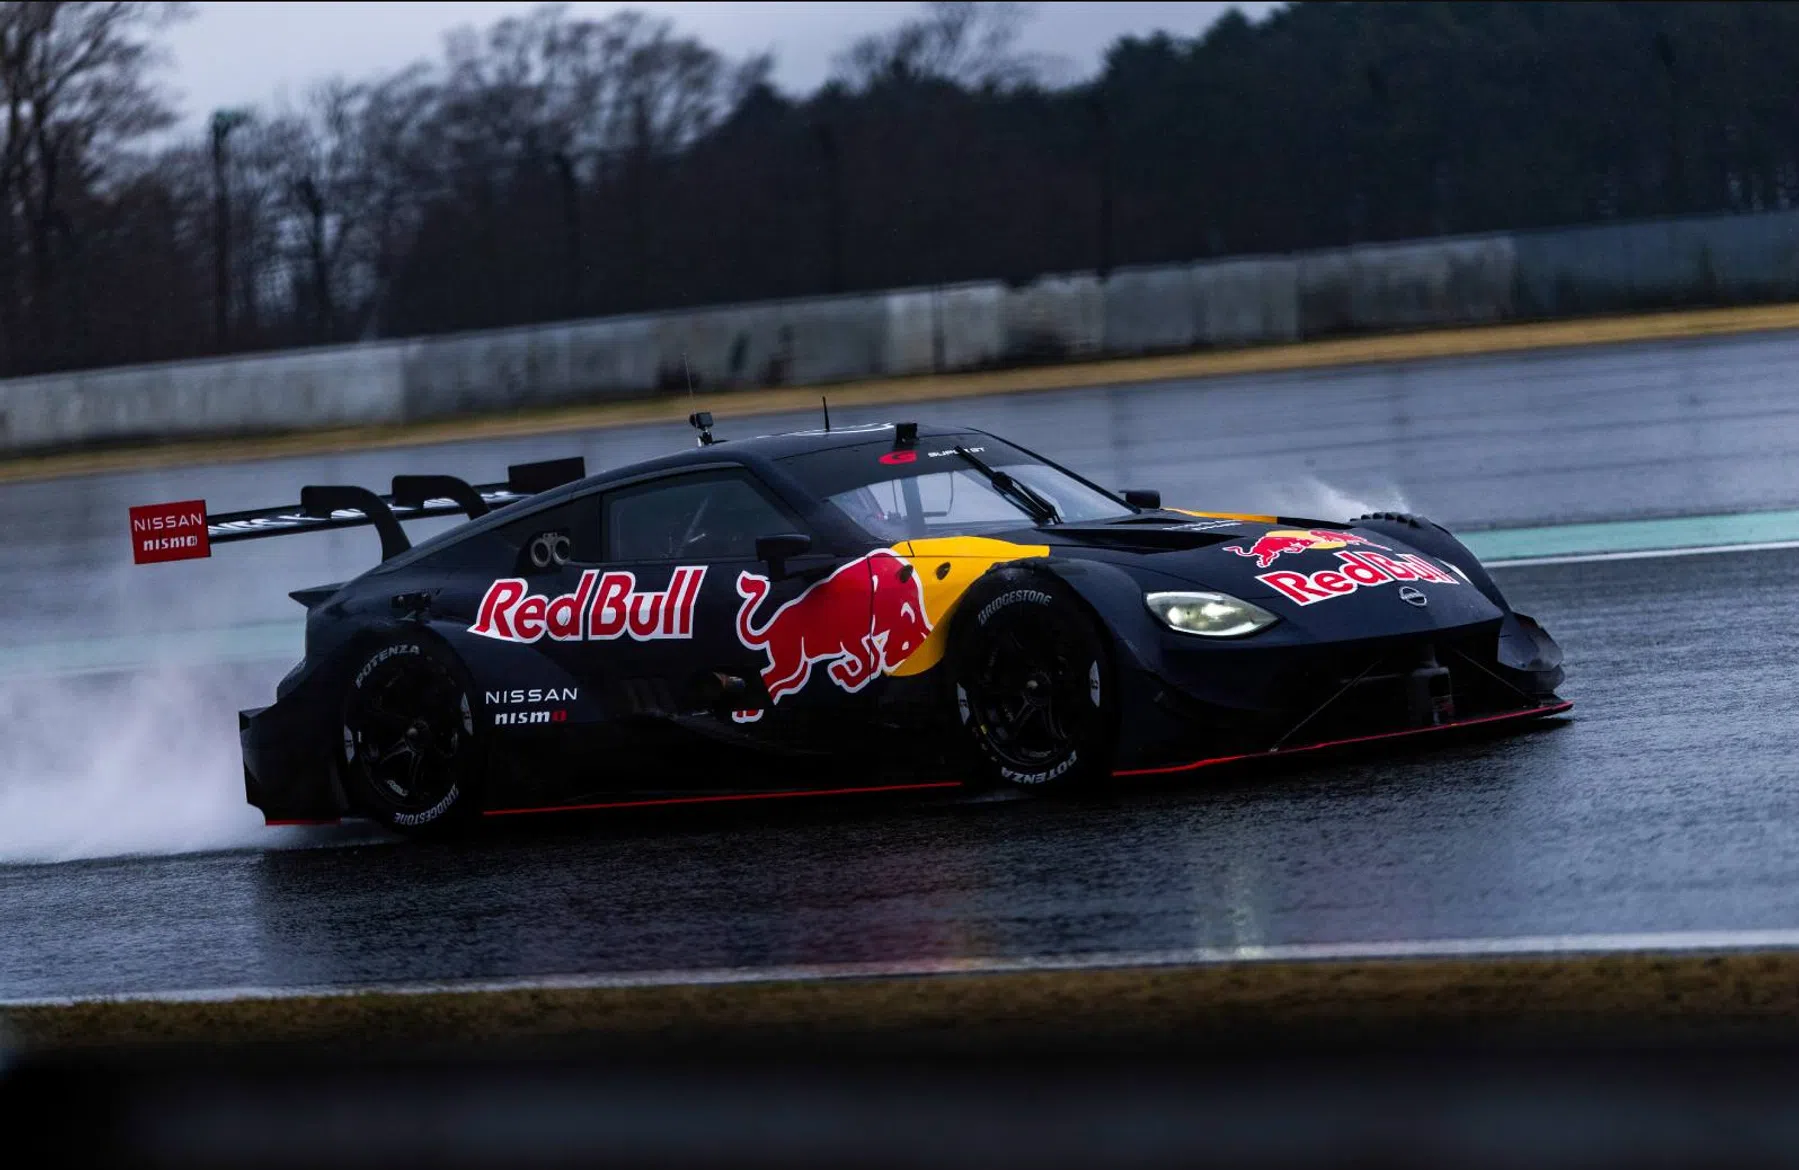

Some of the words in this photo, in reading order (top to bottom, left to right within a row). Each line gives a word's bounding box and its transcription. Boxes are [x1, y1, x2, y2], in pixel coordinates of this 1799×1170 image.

[134, 513, 203, 533] NISSAN
[977, 589, 1053, 628] BRIDGESTONE
[355, 644, 421, 689] POTENZA
[486, 688, 578, 705] NISSAN
[1000, 749, 1077, 784] POTENZA
